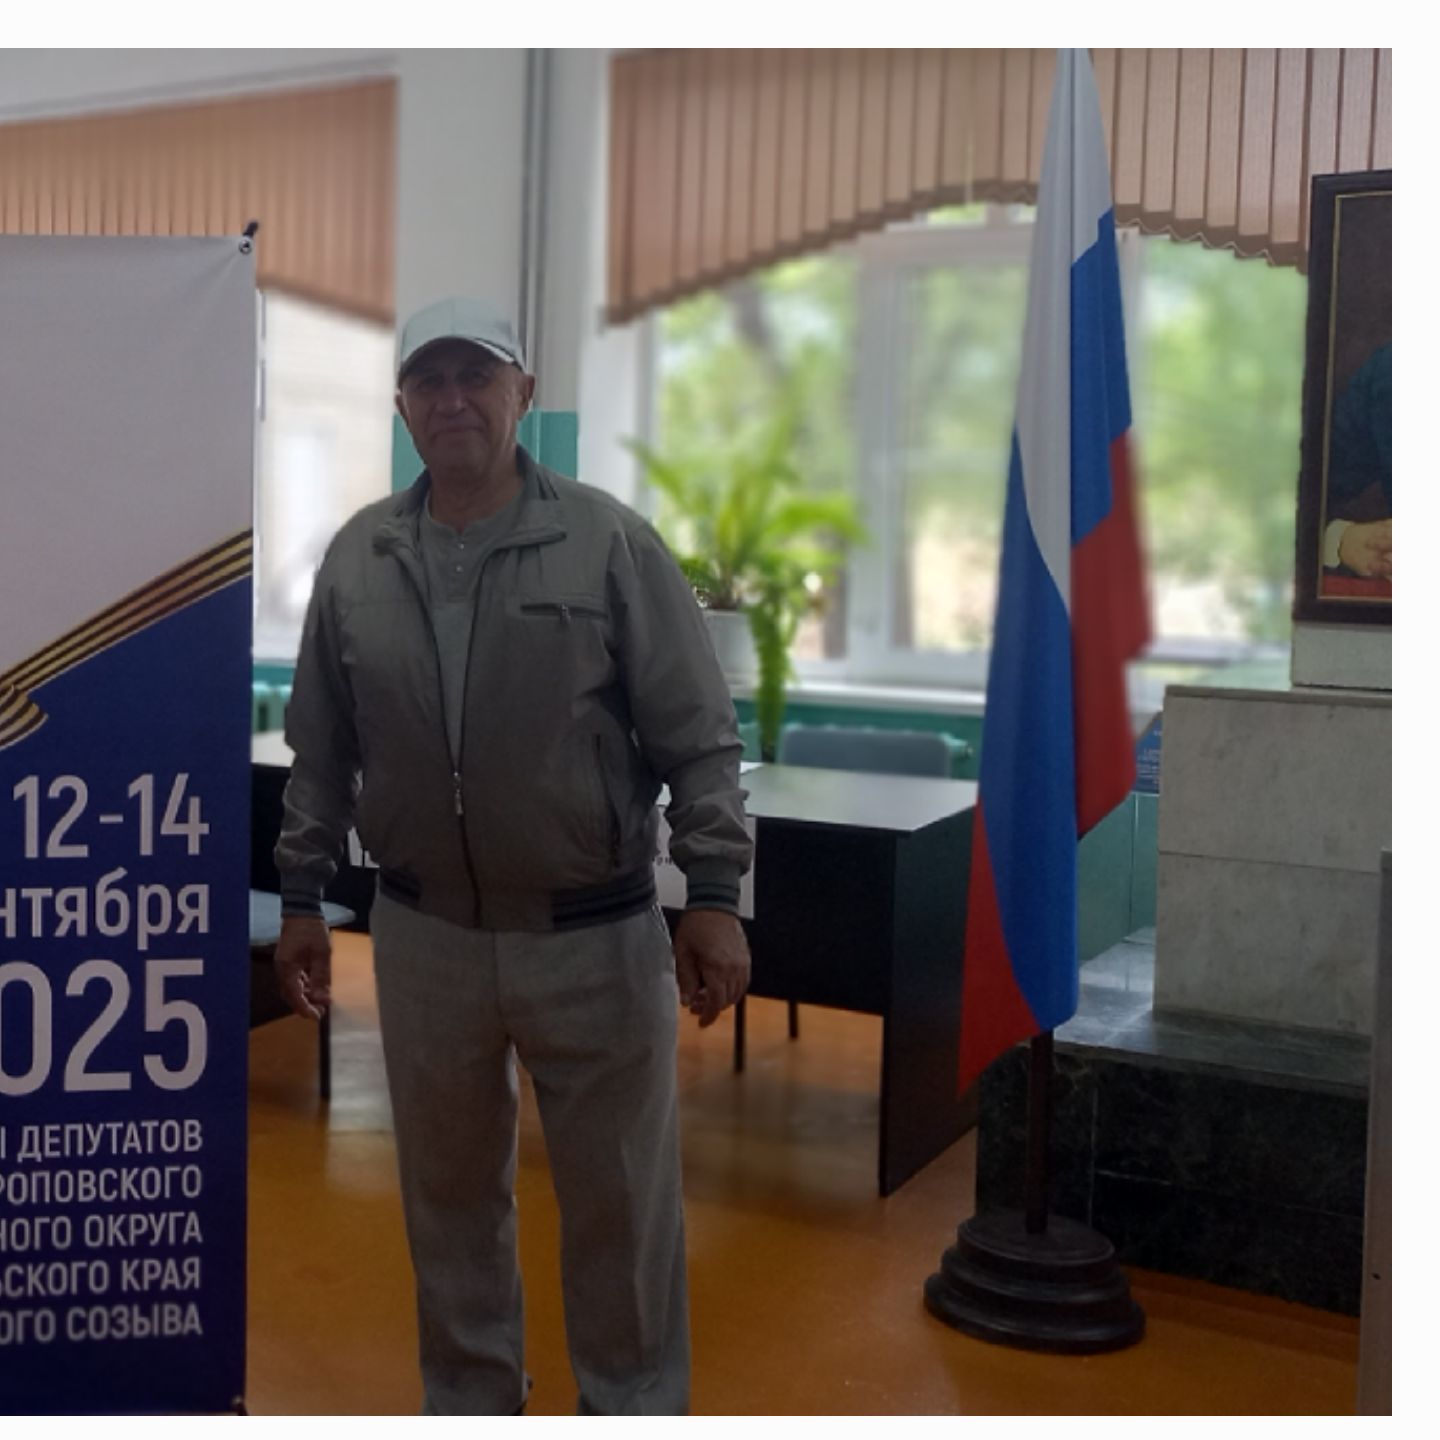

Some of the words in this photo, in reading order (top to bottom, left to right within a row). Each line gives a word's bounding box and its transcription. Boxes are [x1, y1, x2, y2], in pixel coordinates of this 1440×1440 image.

[13, 772, 210, 859] 12-14
[16, 1119, 203, 1163] ДЕПУТАТОВ
[84, 1211, 203, 1248] ОКРУГА
[121, 1256, 201, 1292] КРАЯ
[66, 1303, 203, 1342] СОЗЫВА
